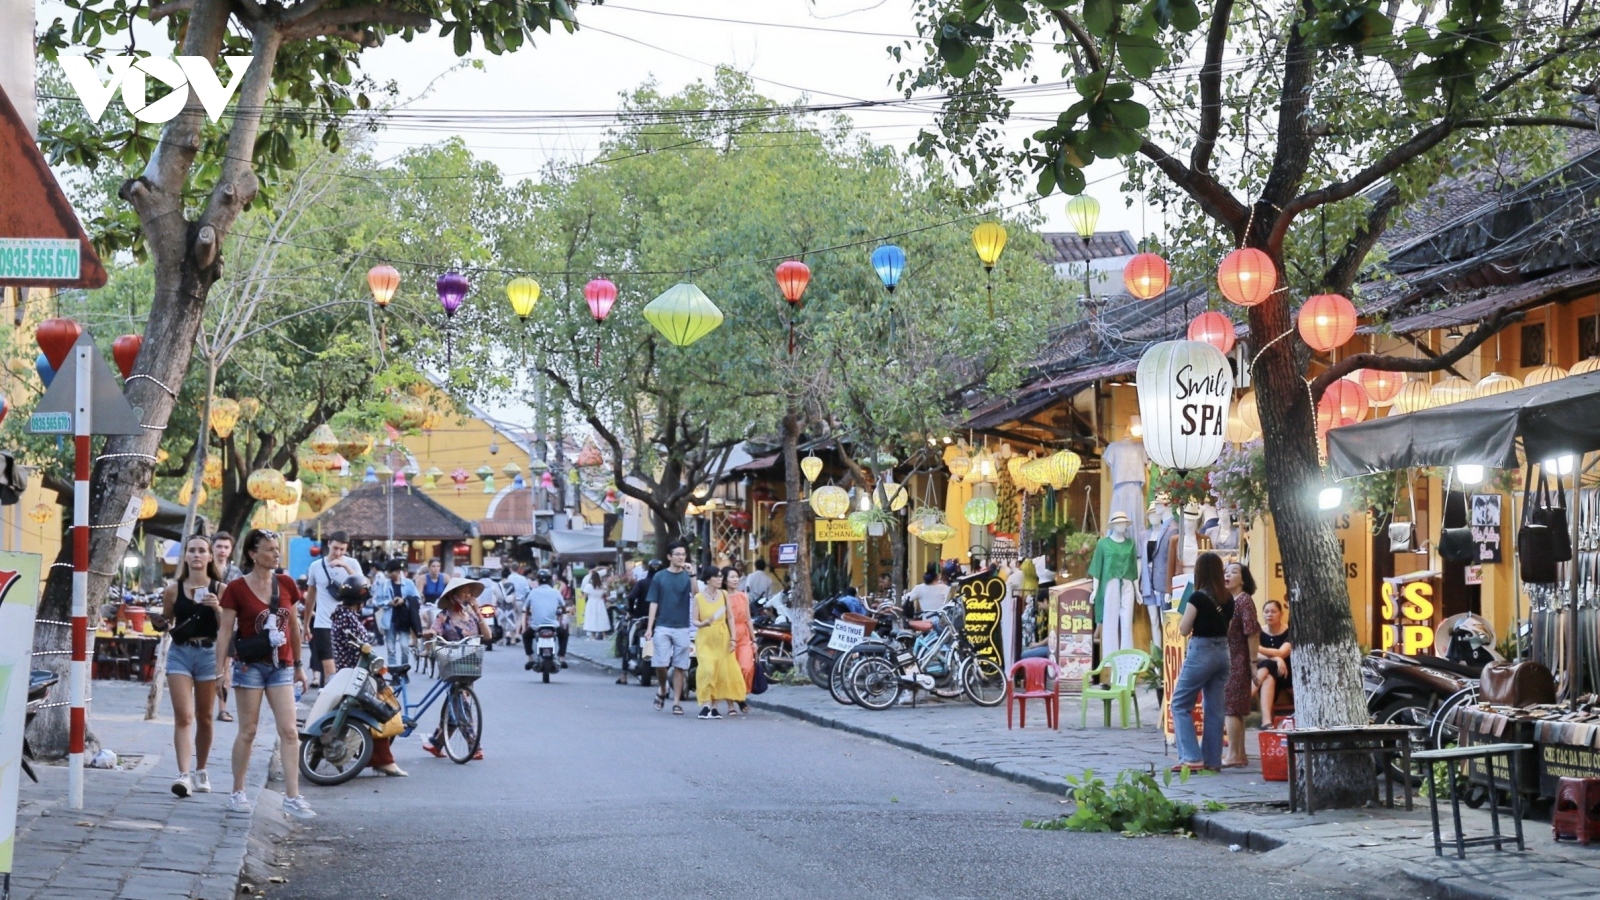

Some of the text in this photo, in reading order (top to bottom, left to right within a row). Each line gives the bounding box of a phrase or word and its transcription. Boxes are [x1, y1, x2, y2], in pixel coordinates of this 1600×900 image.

[0, 247, 78, 277] 0935.565.670
[1176, 364, 1227, 400] Smile
[1181, 404, 1222, 436] SPA
[965, 612, 996, 621] ASSAGE
[1060, 614, 1093, 633] Spa
